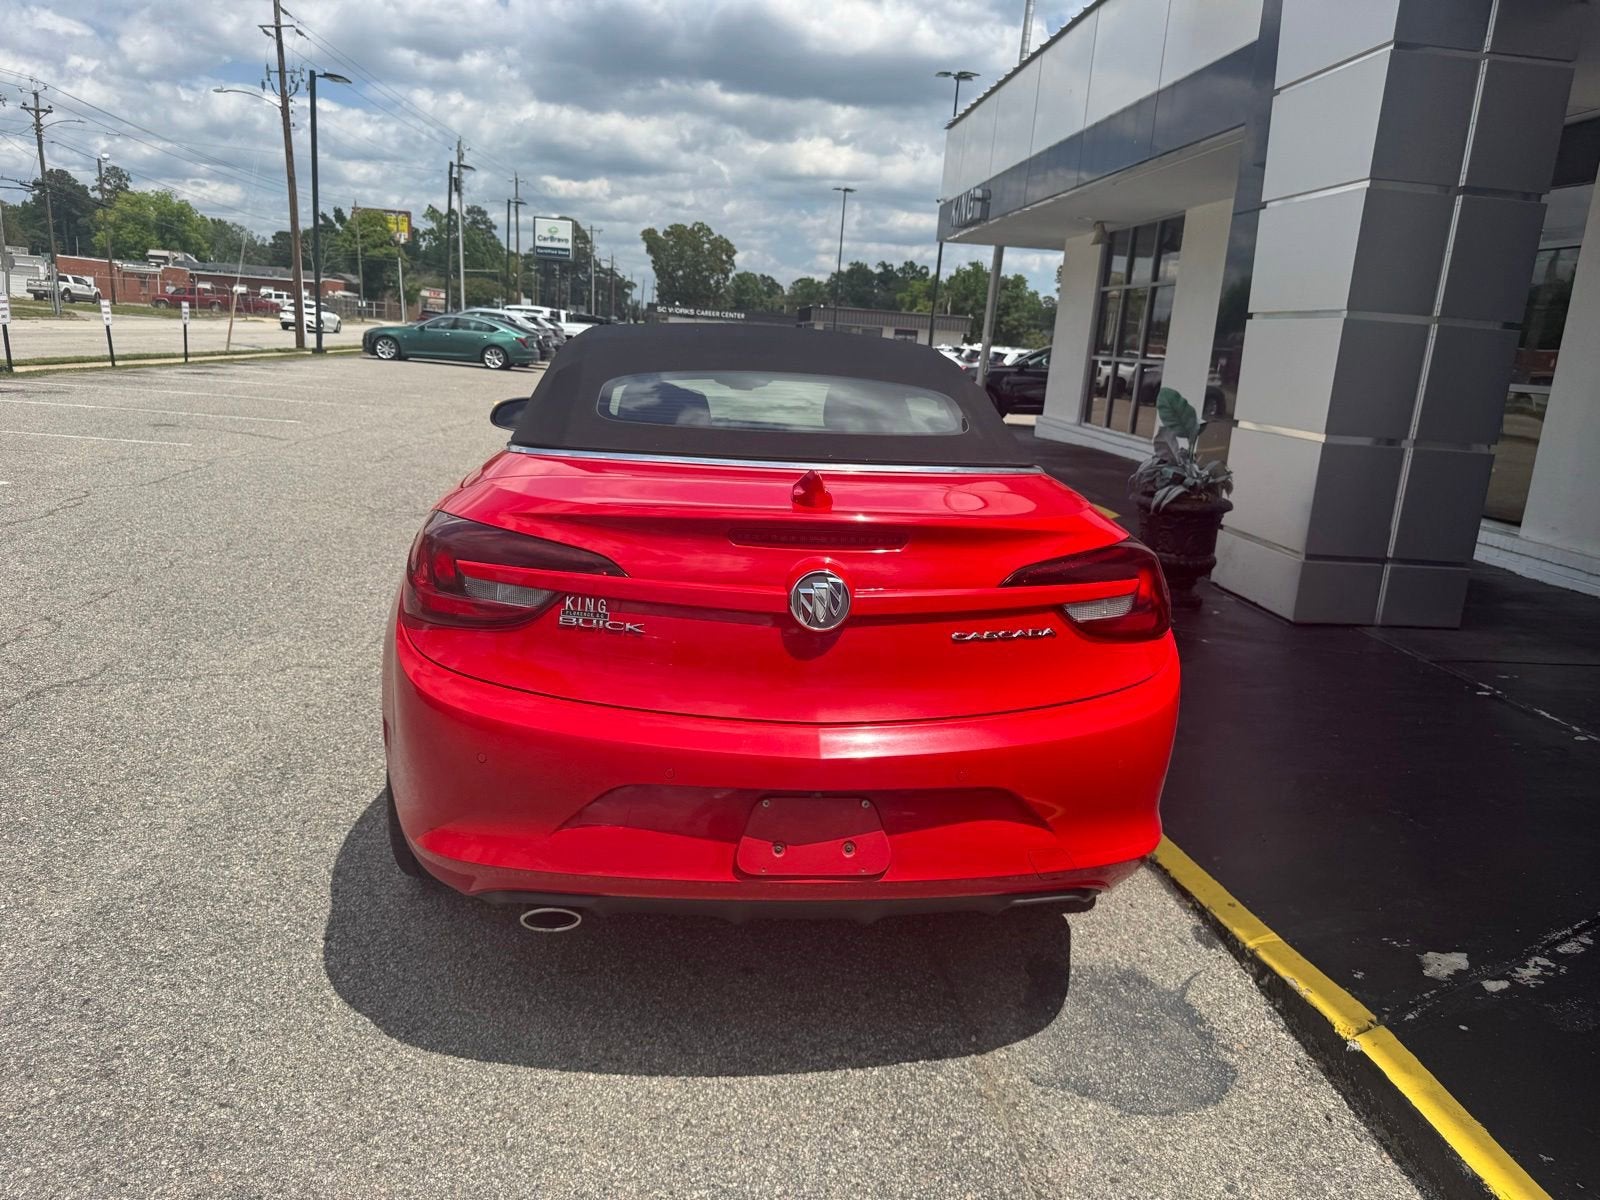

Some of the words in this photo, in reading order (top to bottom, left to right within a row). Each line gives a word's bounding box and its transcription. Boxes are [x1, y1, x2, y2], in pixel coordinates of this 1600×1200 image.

[696, 309, 720, 317] CAREER
[721, 311, 745, 319] CENTER
[565, 596, 607, 613] KING
[559, 616, 645, 633] BUICK
[951, 627, 1055, 641] CASCADA
